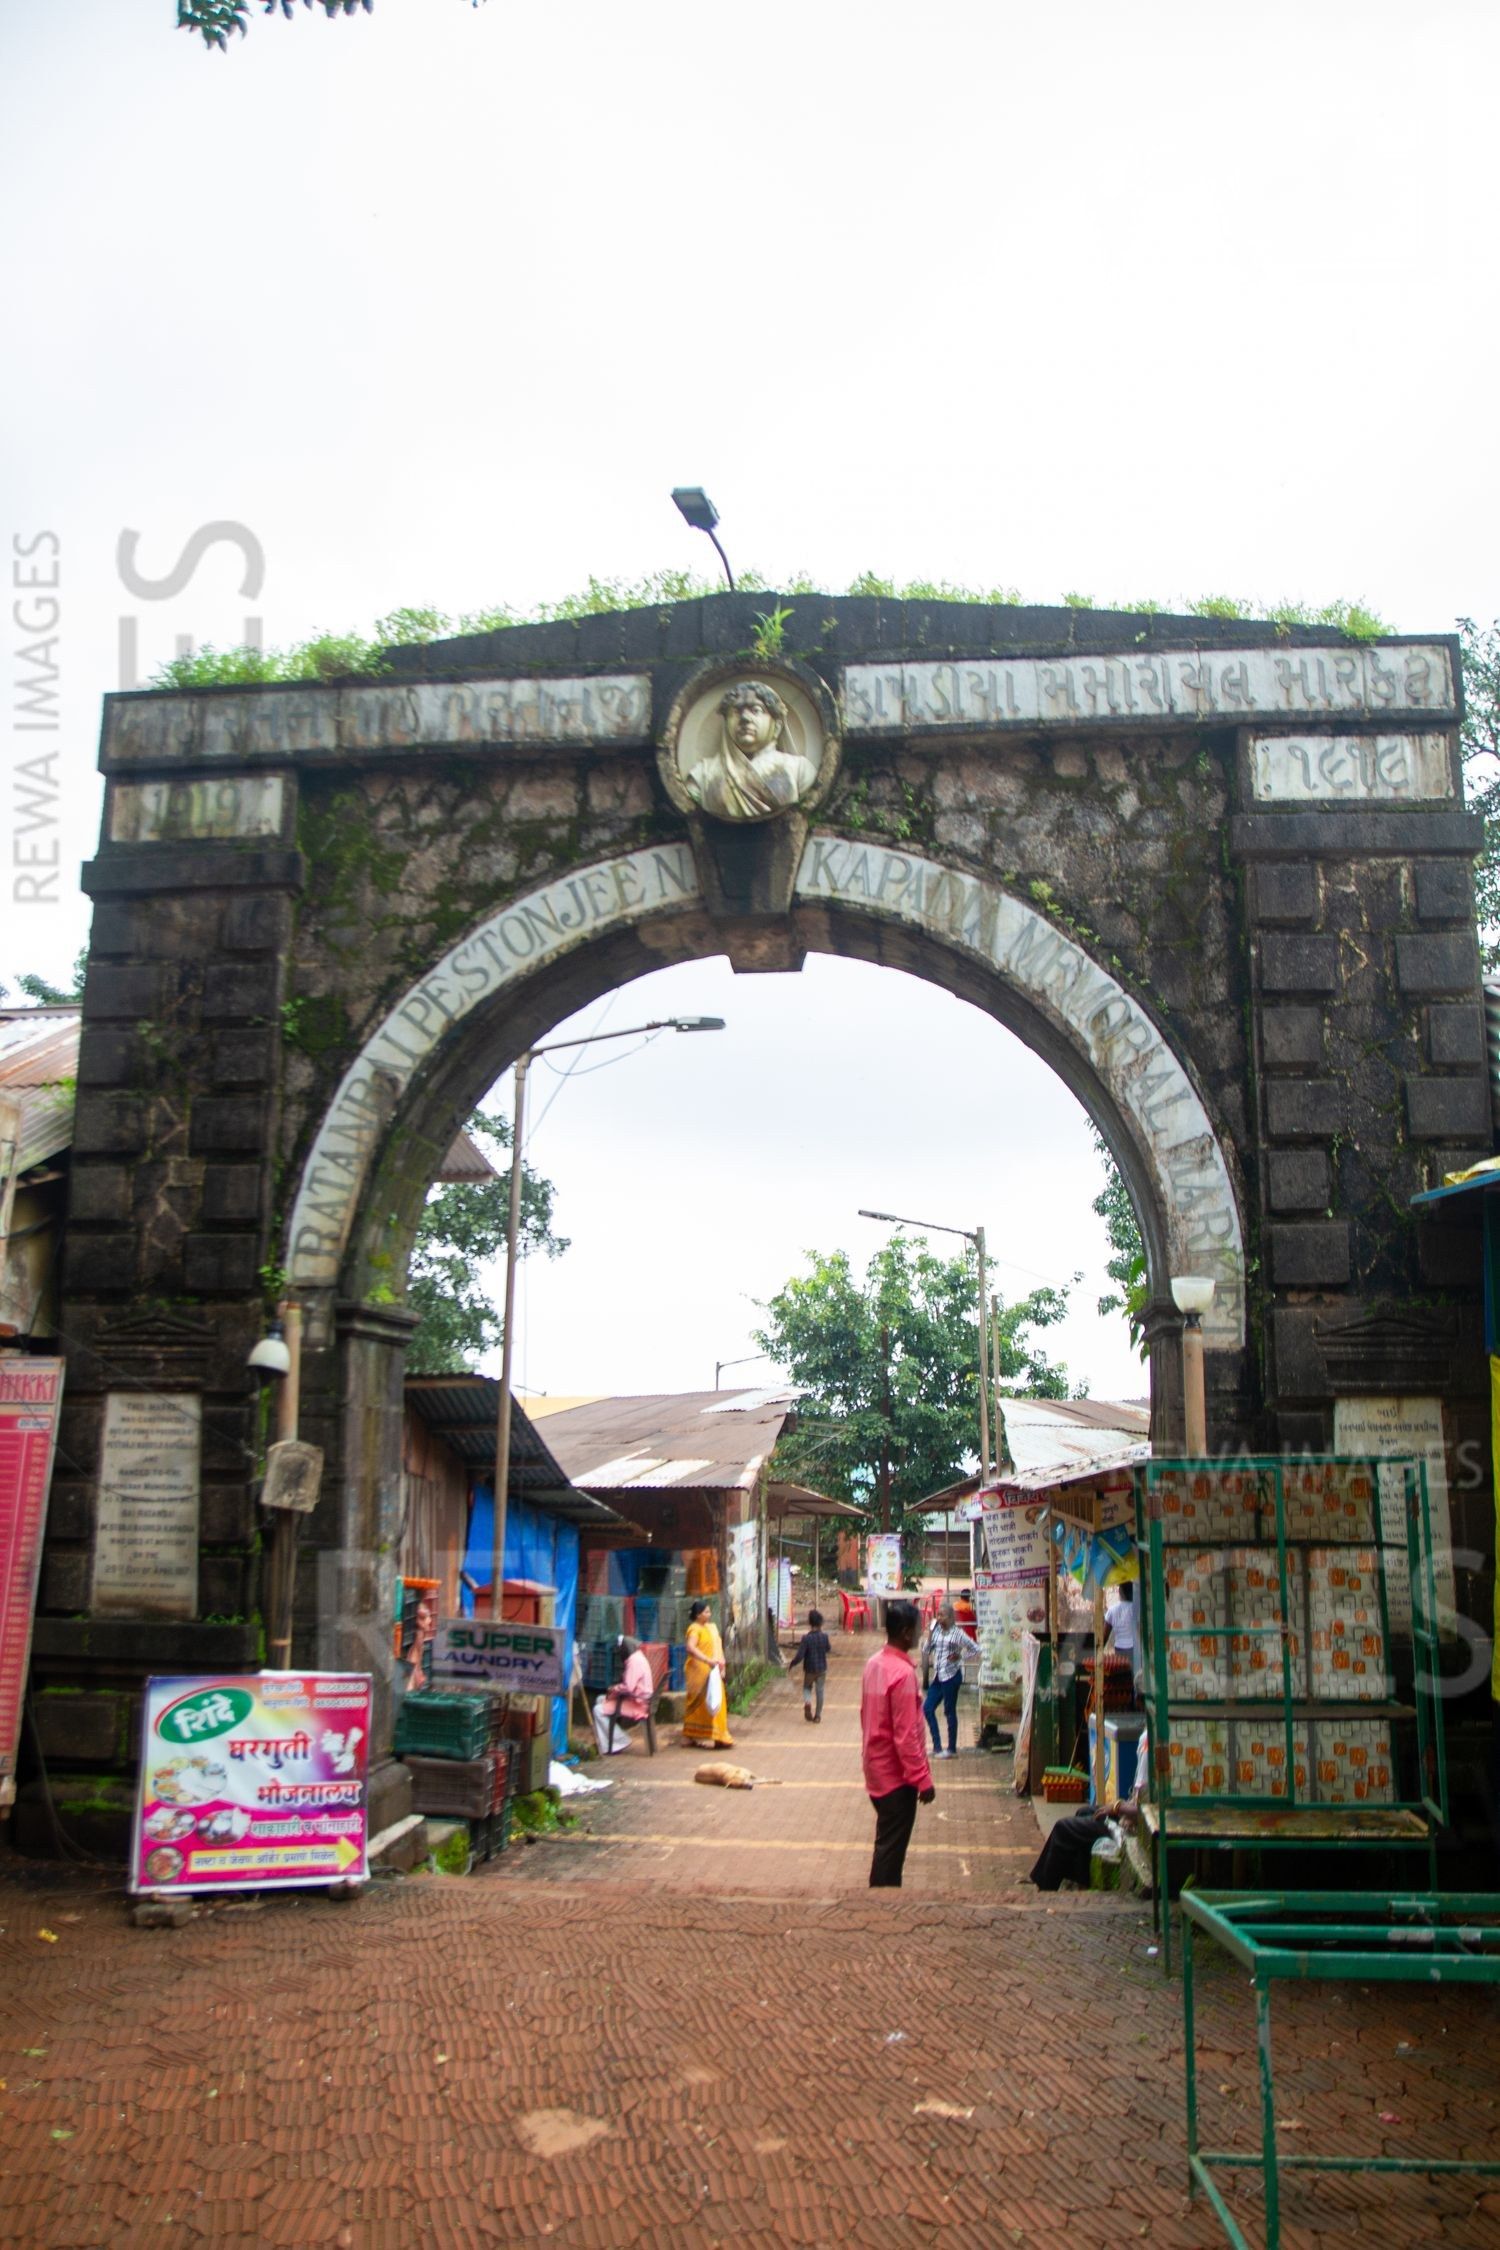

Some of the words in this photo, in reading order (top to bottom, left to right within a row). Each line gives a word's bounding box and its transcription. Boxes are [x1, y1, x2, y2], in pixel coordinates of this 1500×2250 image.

[1288, 743, 1410, 792] ૧૯૧૯
[148, 784, 242, 835] 1919
[399, 860, 647, 1042] PESTONJEE
[651, 846, 699, 900] N.
[446, 1629, 554, 1657] SUPER
[173, 1692, 237, 1742] शिंदे
[228, 1728, 313, 1768] घरगुती
[256, 1777, 362, 1806] भोजनालय
